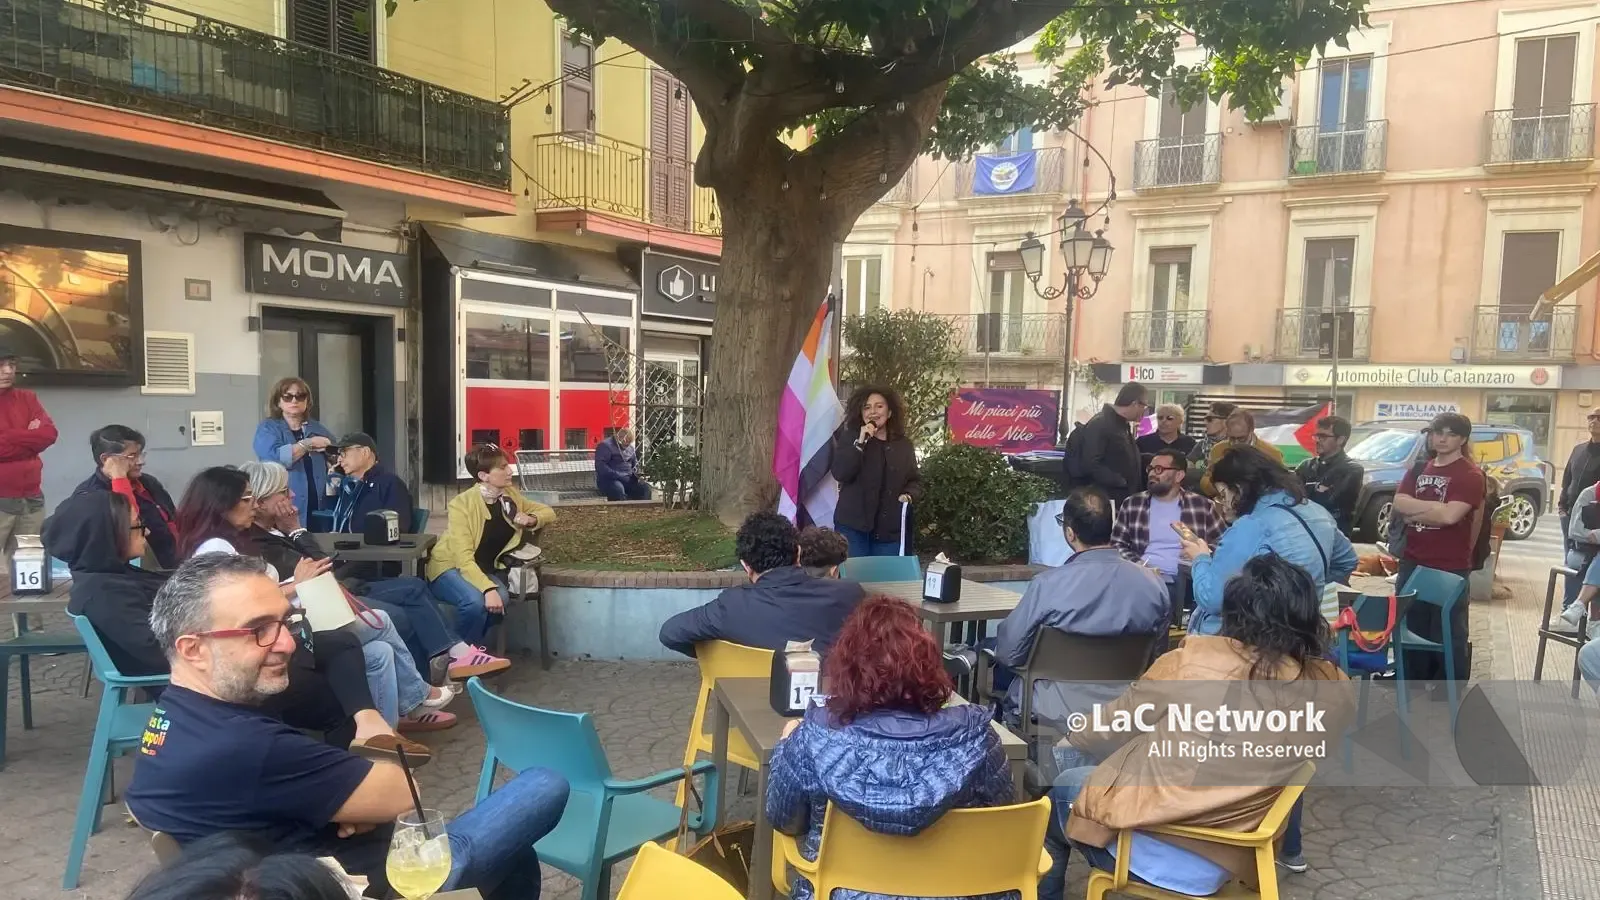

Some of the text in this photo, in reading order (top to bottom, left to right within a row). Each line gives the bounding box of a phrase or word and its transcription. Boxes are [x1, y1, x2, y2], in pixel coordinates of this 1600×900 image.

[262, 243, 403, 288] MOMA
[263, 277, 405, 299] LOUNGE
[1326, 368, 1515, 385] Automobile Club Catanzaro
[961, 401, 985, 416] Mi
[981, 404, 1017, 421] piaci
[1395, 404, 1457, 413] ITALIANA
[964, 424, 1035, 442] delle Nike
[389, 527, 399, 538] 18
[19, 571, 40, 586] 16
[793, 686, 816, 705] 17
